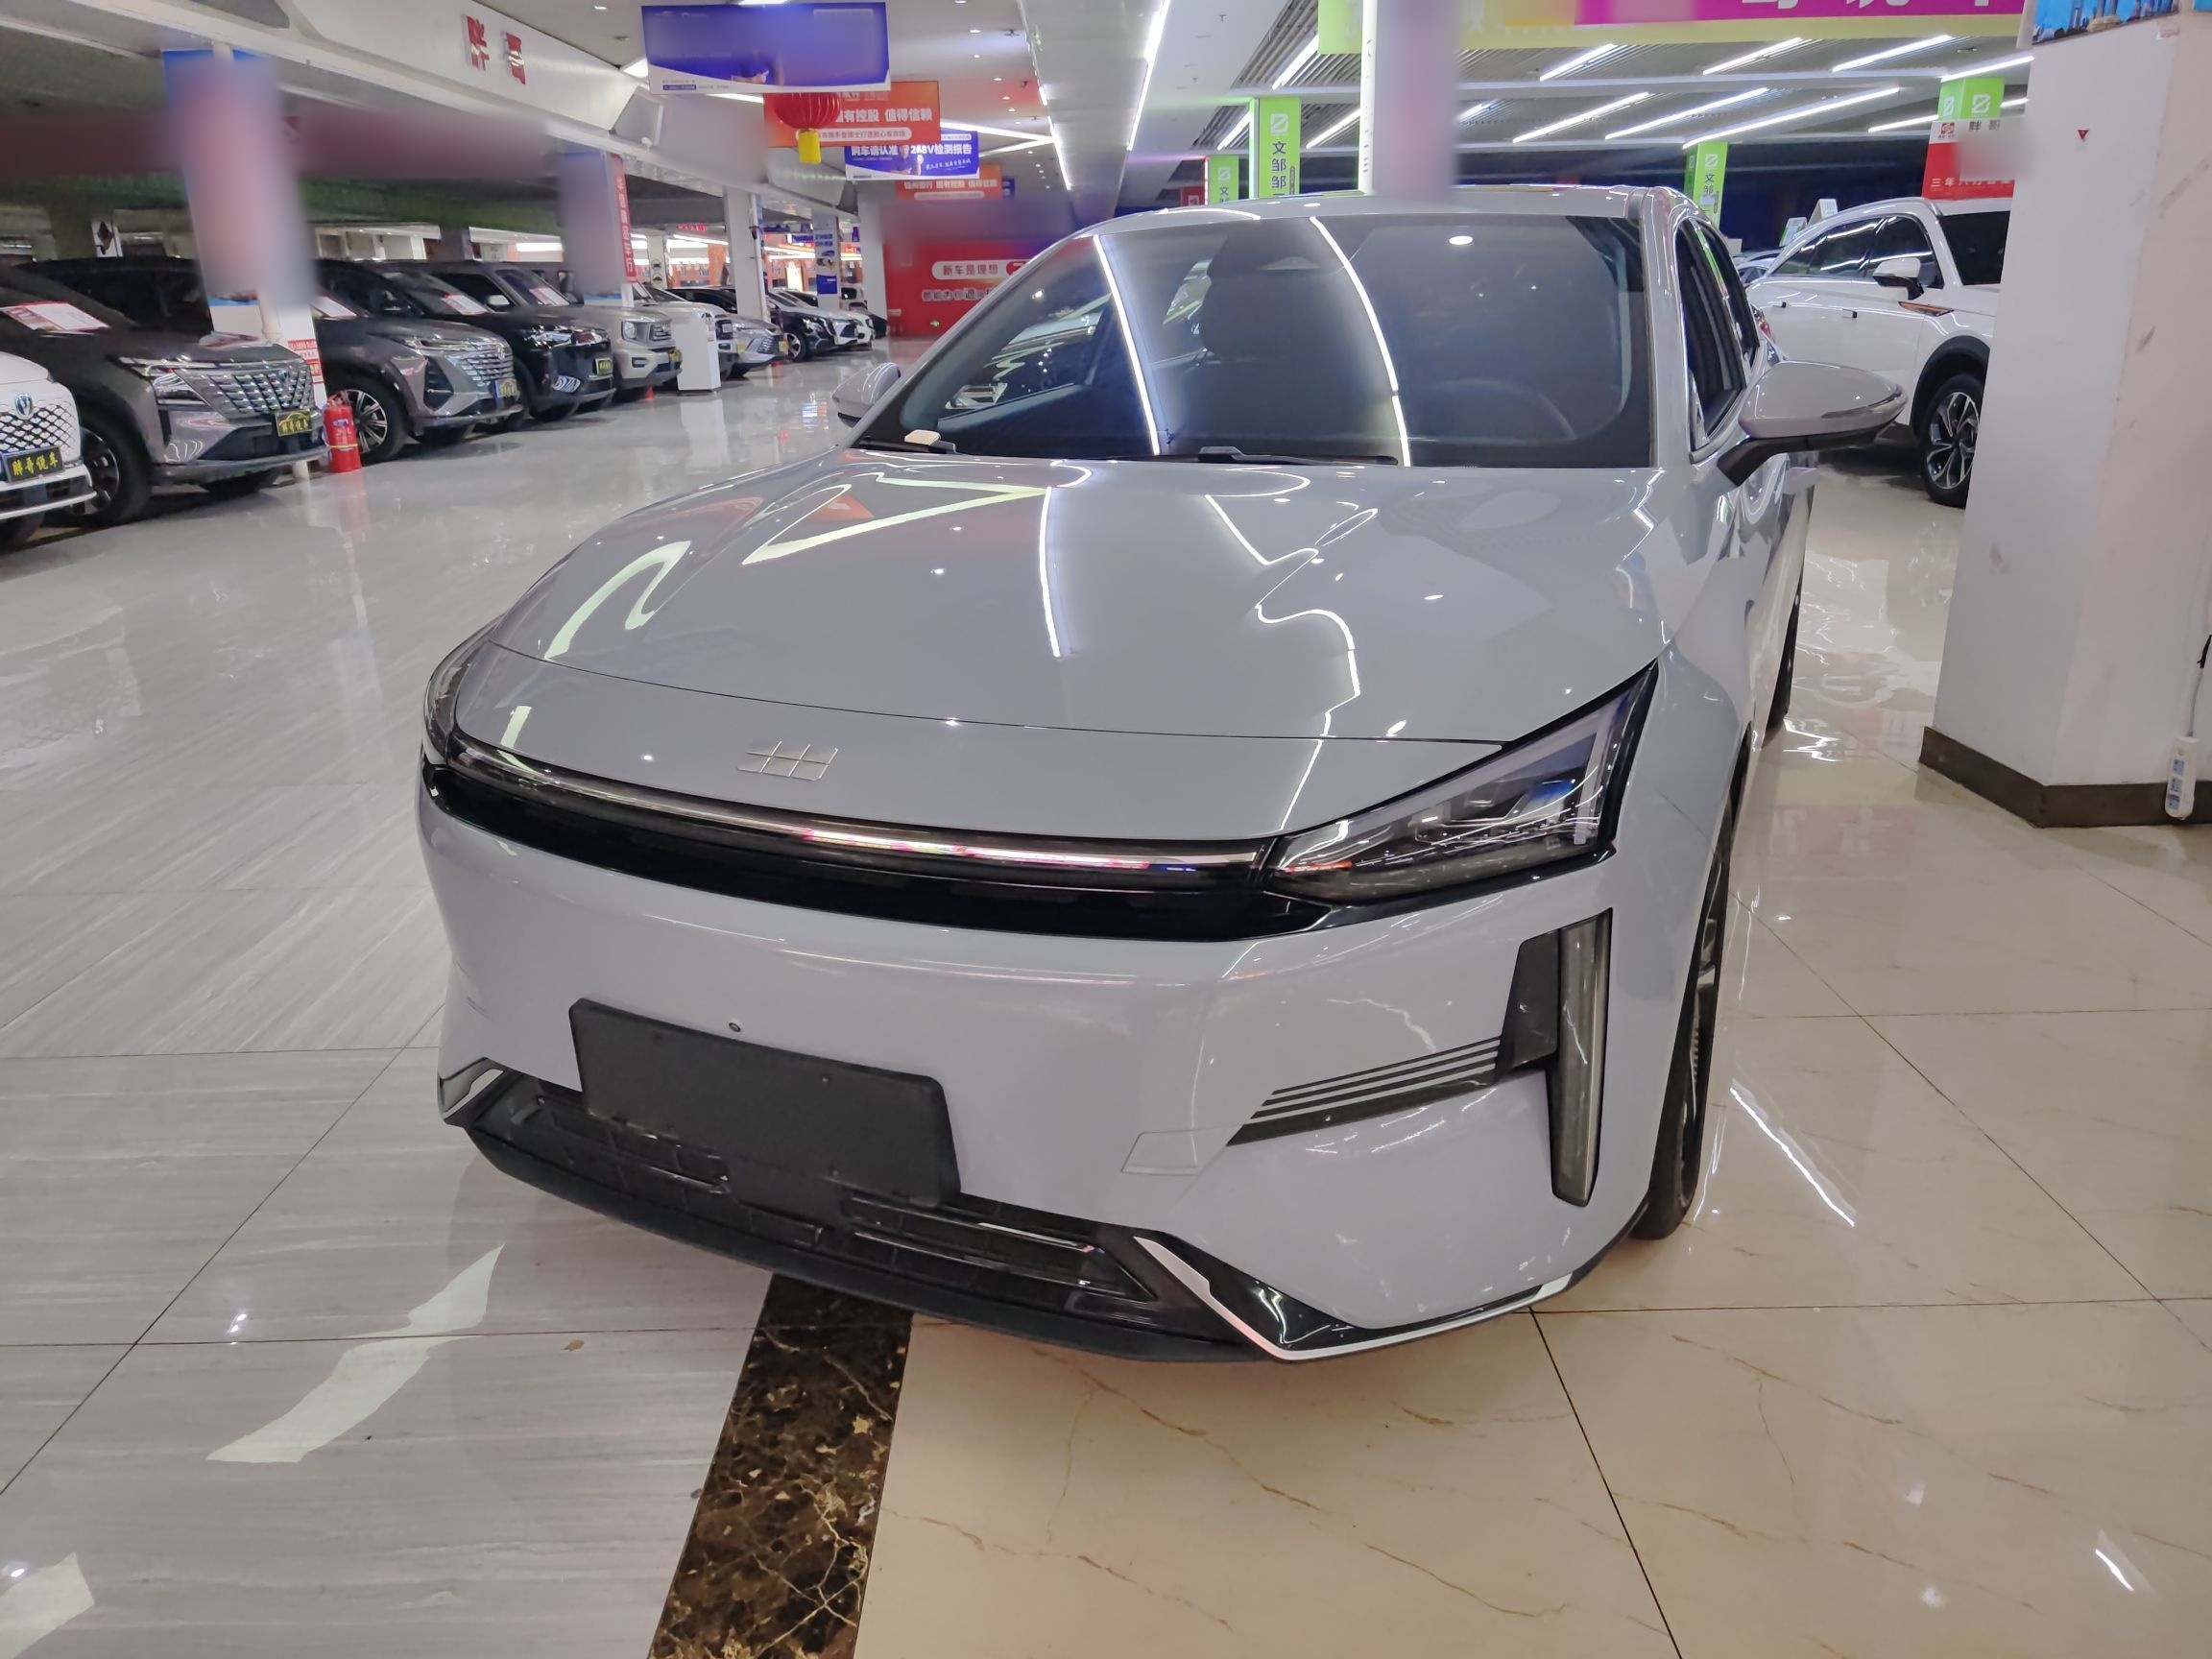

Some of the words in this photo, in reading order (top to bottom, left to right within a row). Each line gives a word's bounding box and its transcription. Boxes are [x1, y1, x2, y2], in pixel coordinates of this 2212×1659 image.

[884, 107, 933, 122] 值得信赖
[909, 142, 973, 156] 268V检测报告
[942, 263, 998, 276] 新车是理想
